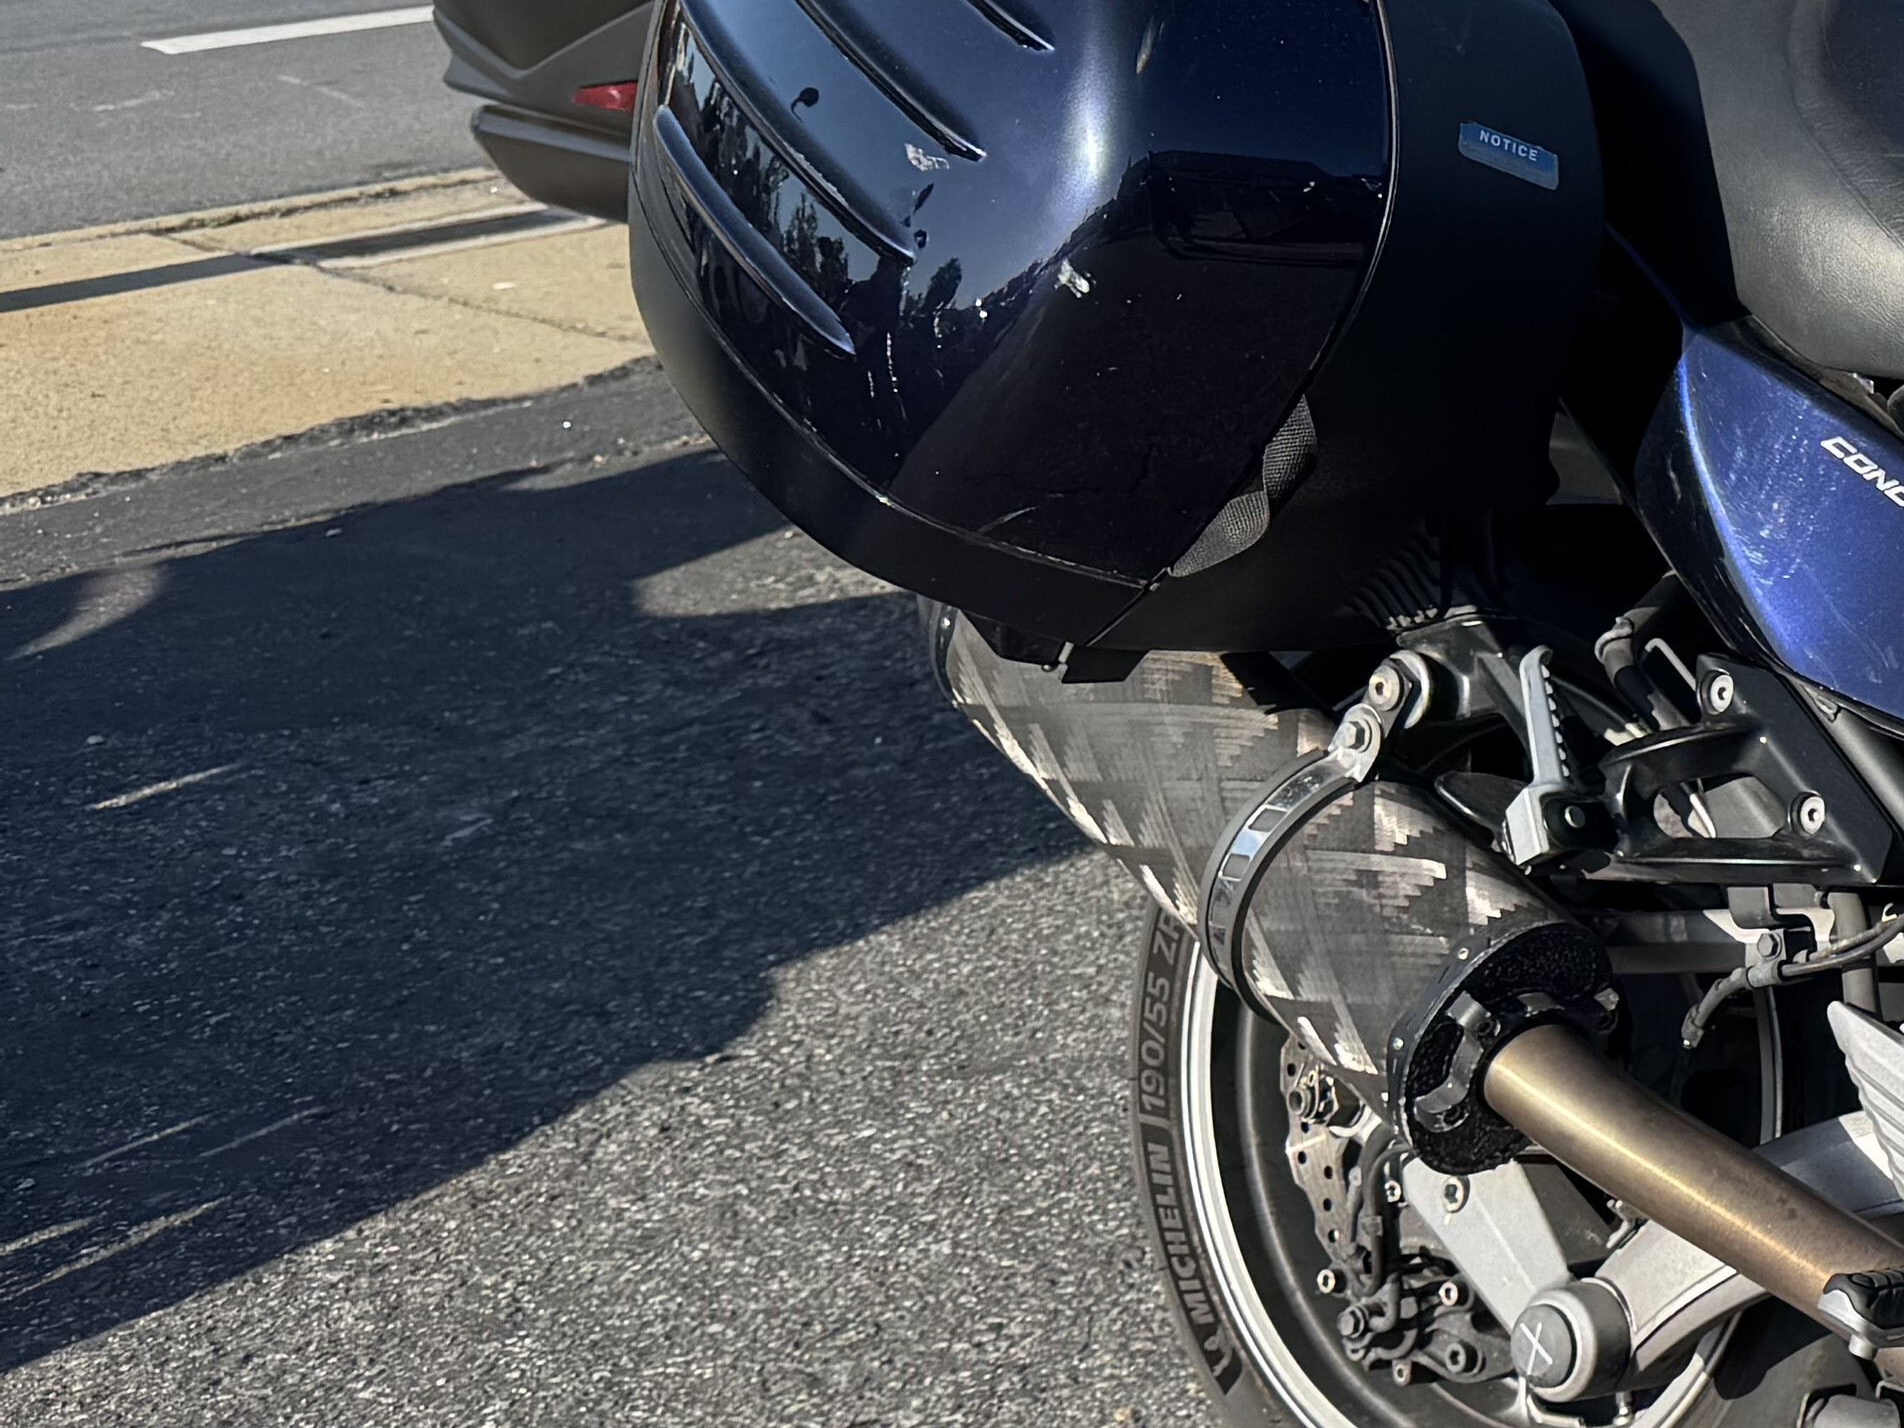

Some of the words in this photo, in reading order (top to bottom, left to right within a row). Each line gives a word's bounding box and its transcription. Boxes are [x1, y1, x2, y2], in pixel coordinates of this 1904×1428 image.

[1479, 129, 1539, 162] NOTICE
[1140, 972, 1171, 1112] 190/55
[1147, 1142, 1216, 1325] MICHELIN
